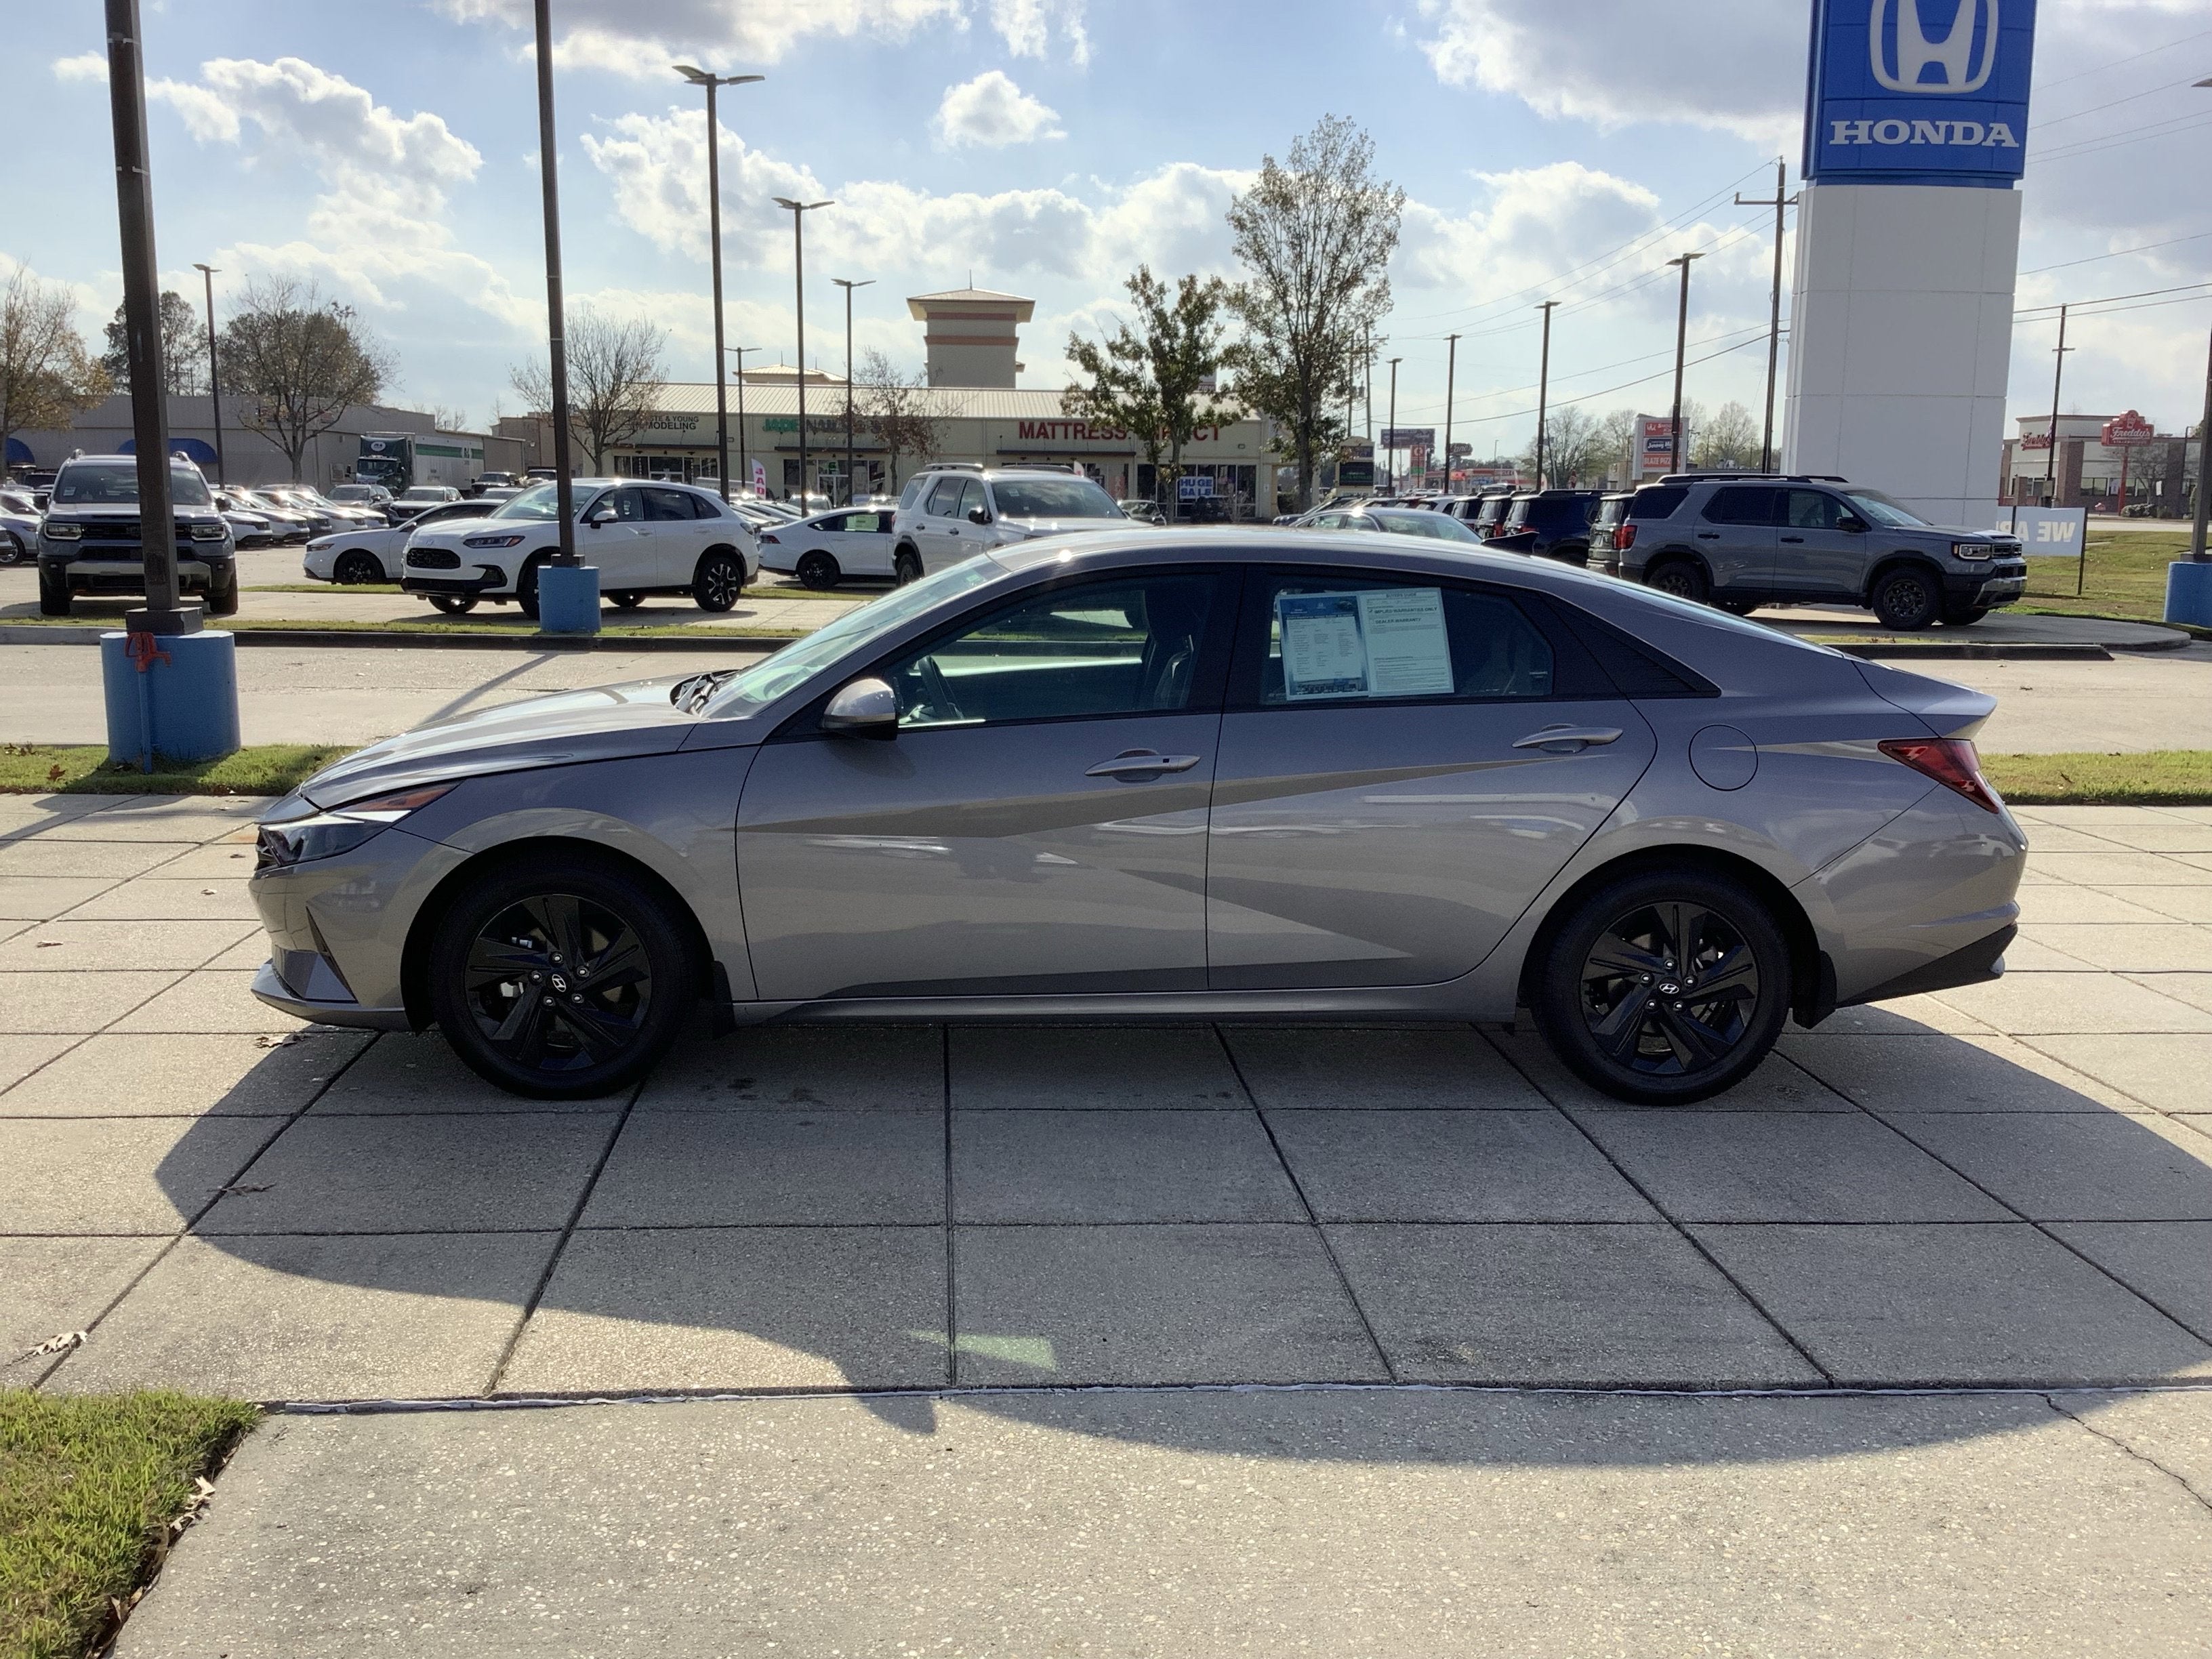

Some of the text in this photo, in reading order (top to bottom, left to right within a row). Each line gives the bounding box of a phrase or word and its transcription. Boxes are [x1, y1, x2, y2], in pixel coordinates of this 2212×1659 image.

[1829, 119, 2020, 148] HONDA
[1019, 421, 1128, 441] MATTRESS
[2110, 426, 2151, 438] Freddy's
[1181, 488, 1212, 496] SALE
